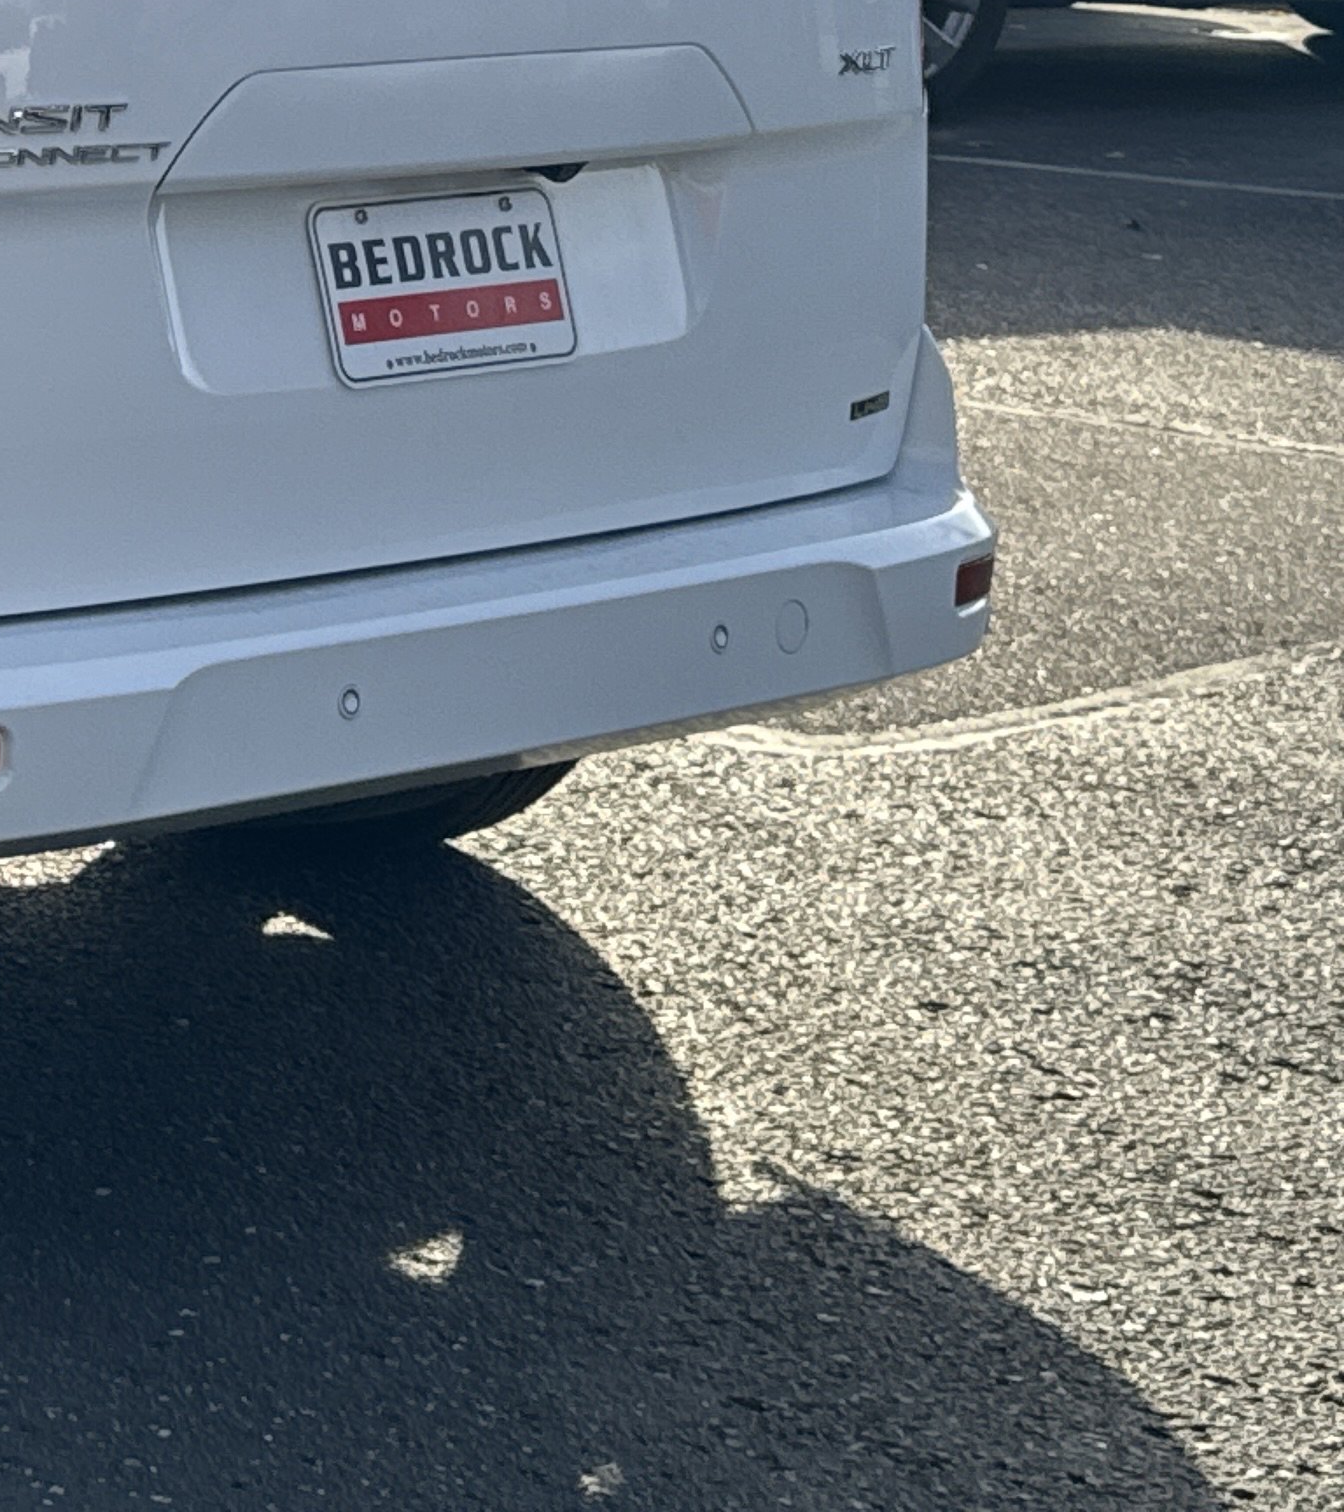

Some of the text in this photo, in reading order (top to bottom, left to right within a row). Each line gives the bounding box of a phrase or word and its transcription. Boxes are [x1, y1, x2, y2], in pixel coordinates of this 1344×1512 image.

[838, 46, 896, 76] XLT
[326, 221, 554, 290] BEDROCK
[350, 292, 553, 333] MOTORS
[395, 342, 528, 367] www.bedrockmotors.com
